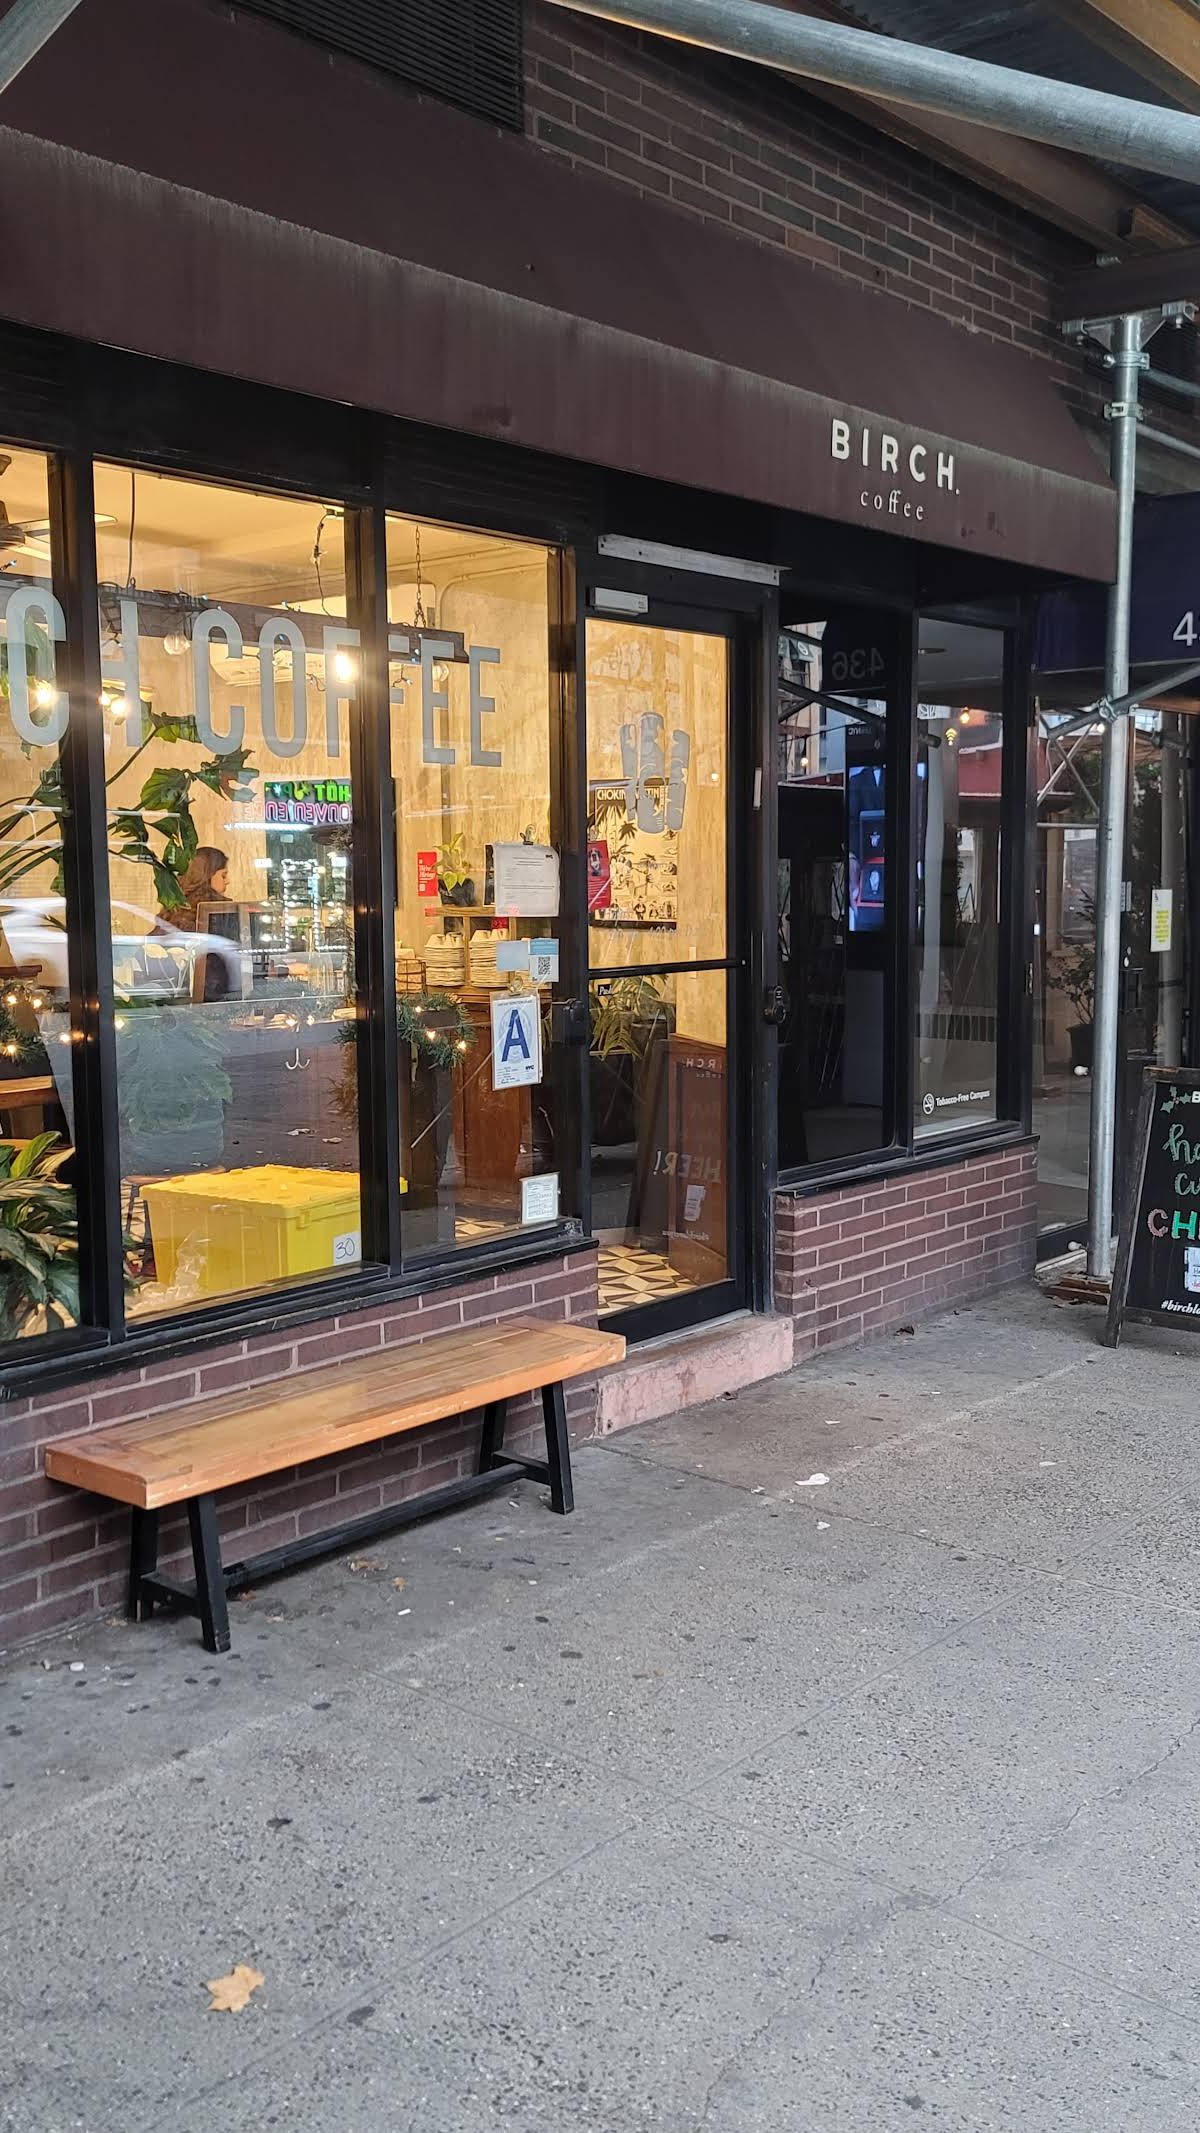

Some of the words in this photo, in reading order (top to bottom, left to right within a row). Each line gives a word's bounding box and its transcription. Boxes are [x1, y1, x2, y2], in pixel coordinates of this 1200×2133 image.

[860, 489, 924, 520] coffee
[1173, 611, 1200, 646] 4
[193, 609, 502, 767] COFEE
[597, 789, 626, 801] CHOKIN
[501, 1009, 531, 1062] A
[935, 1093, 970, 1107] Tobacco-Free
[970, 1090, 991, 1101] Campus
[1147, 1208, 1200, 1240] CH
[335, 1237, 356, 1260] 30
